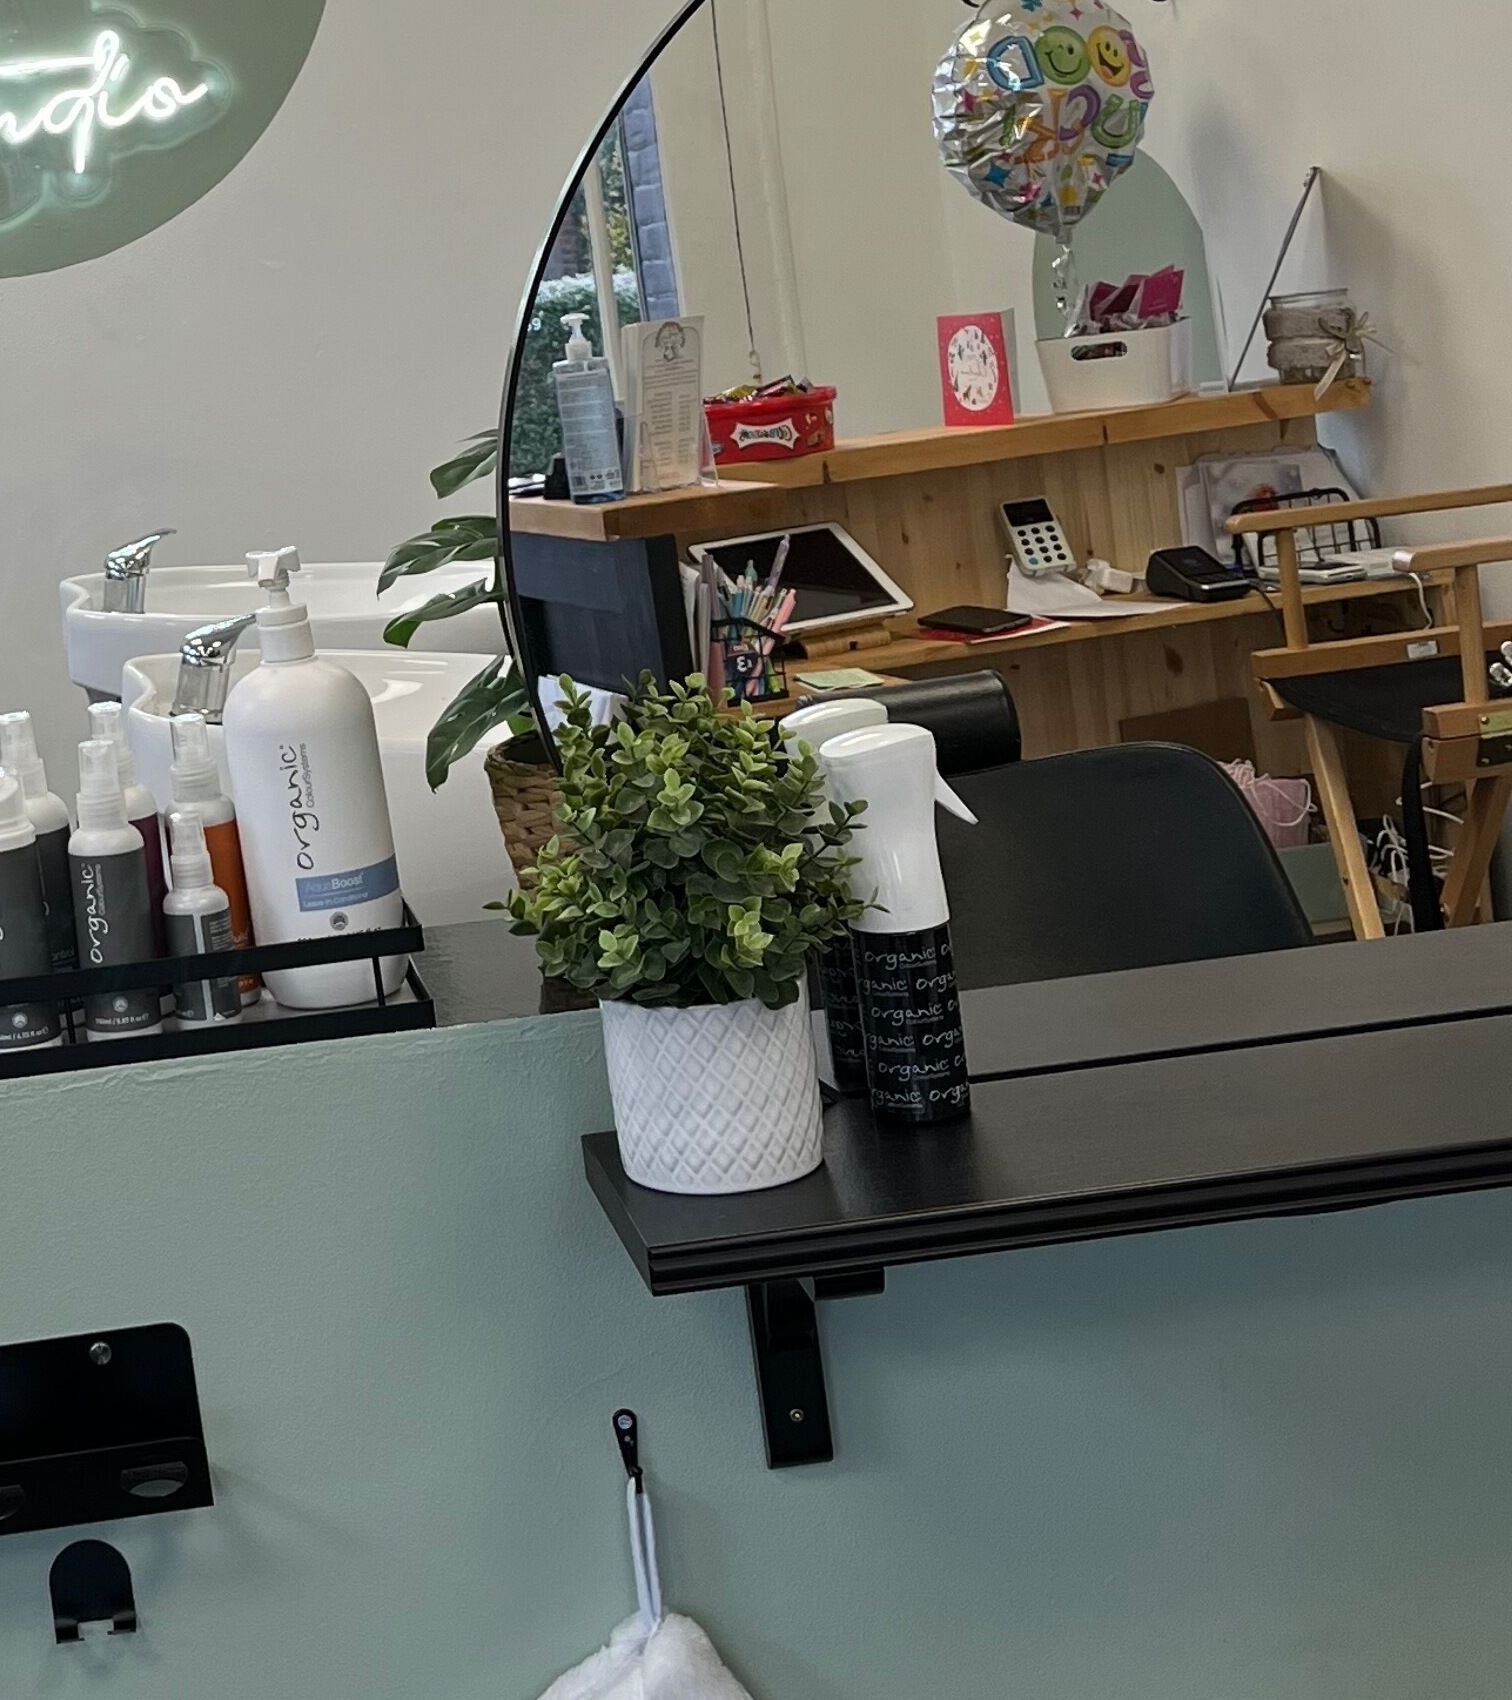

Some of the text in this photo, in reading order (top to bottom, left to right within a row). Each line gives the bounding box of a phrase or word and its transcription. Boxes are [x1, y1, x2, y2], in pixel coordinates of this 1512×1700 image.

[280, 743, 320, 870] organic
[81, 863, 109, 964] organic
[864, 947, 937, 970] organic
[871, 1002, 944, 1026] organic
[865, 1032, 916, 1051] rganic
[878, 1058, 951, 1082] organic
